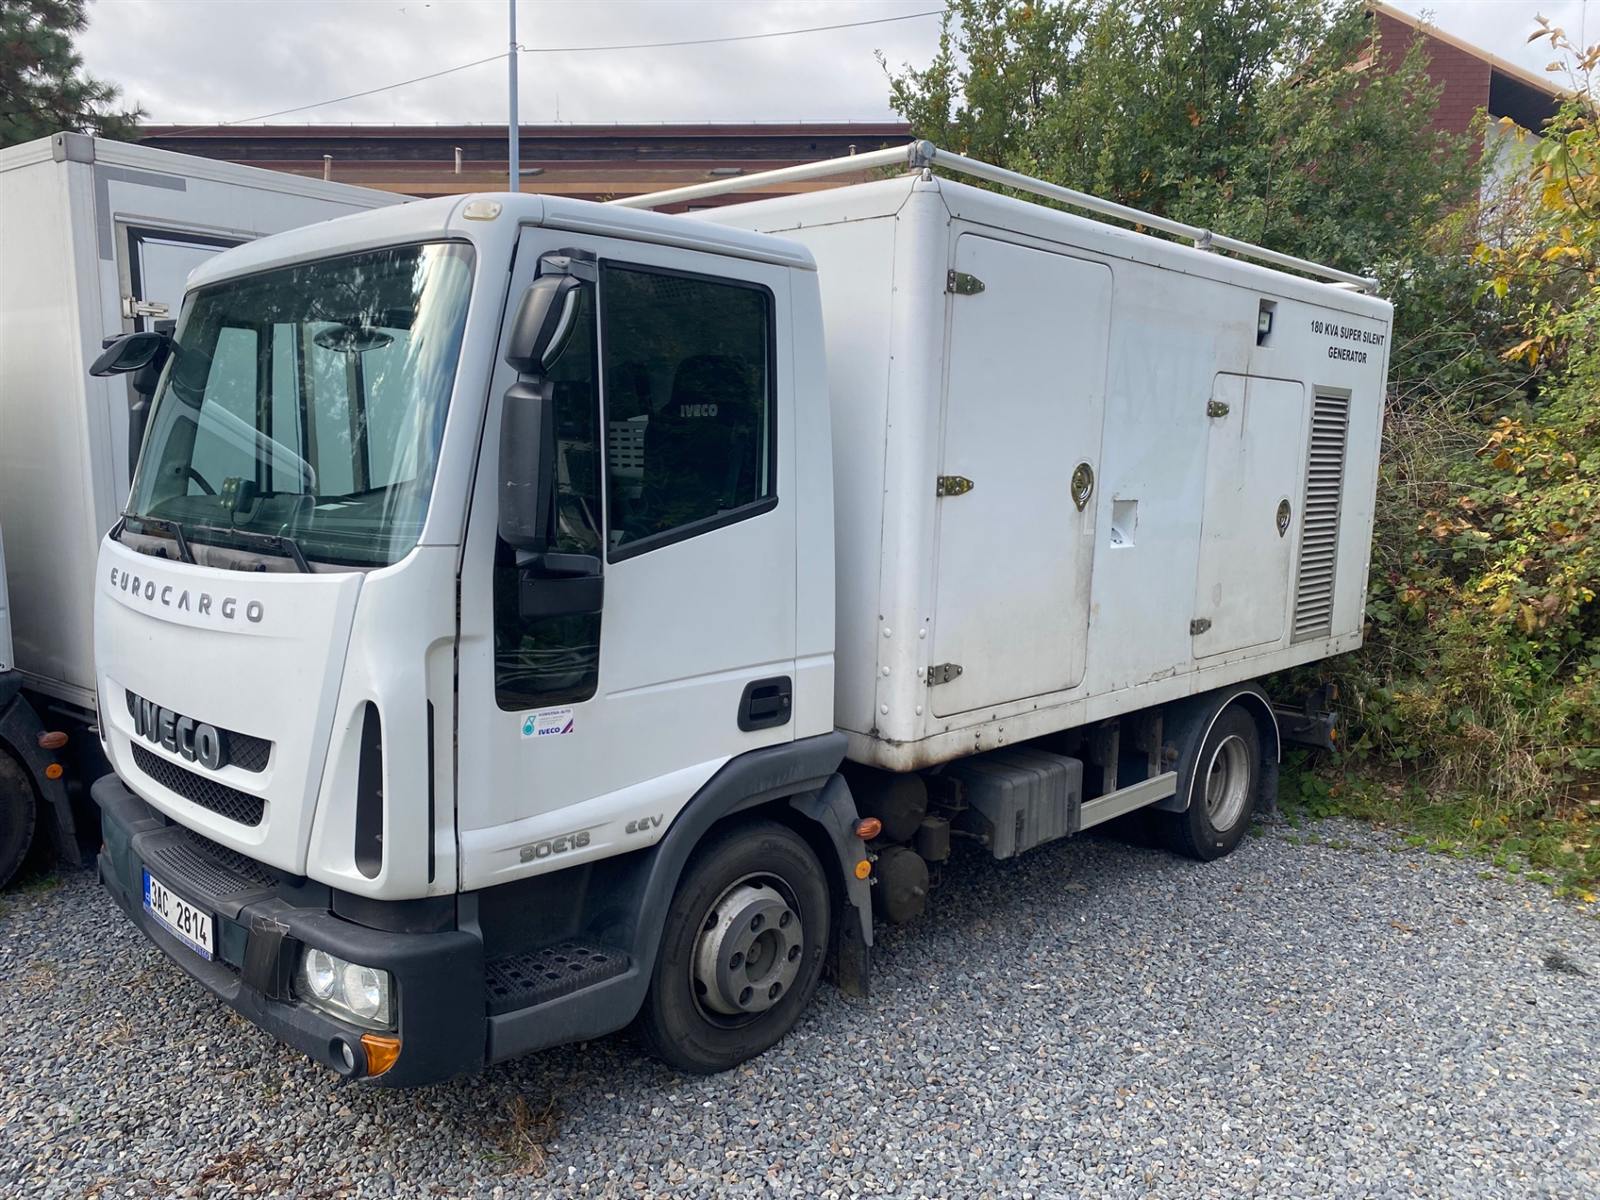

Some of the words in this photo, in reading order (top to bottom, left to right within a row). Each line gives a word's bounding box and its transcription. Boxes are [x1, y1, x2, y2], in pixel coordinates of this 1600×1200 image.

[1311, 320, 1323, 334] 180
[1325, 323, 1338, 337] KVA
[1340, 326, 1361, 342] SUPER
[1363, 331, 1384, 346] SILENT
[1328, 346, 1367, 364] GENERATOR
[680, 404, 718, 417] IVECO
[110, 567, 264, 623] EUROCARGO
[133, 695, 221, 770] IVECO
[538, 727, 560, 735] IVECO
[625, 814, 664, 834] EEV
[151, 881, 169, 917] 3AC
[176, 901, 207, 945] 2814
